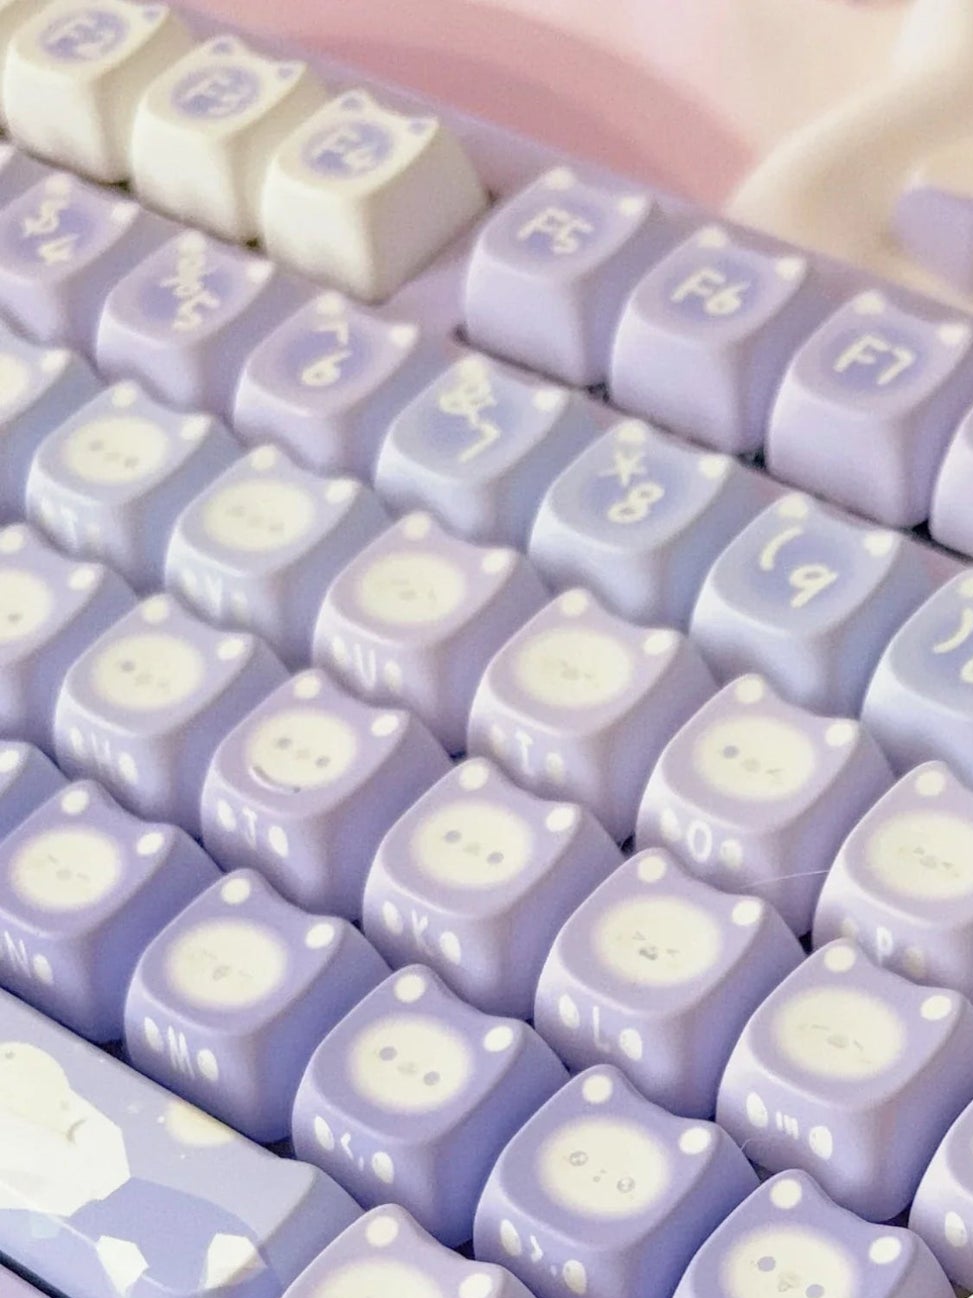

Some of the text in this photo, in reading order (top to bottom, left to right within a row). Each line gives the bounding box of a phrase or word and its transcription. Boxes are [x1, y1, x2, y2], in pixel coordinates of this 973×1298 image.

[669, 267, 752, 315] F6
[831, 333, 915, 386] F7
[787, 563, 837, 608] 9
